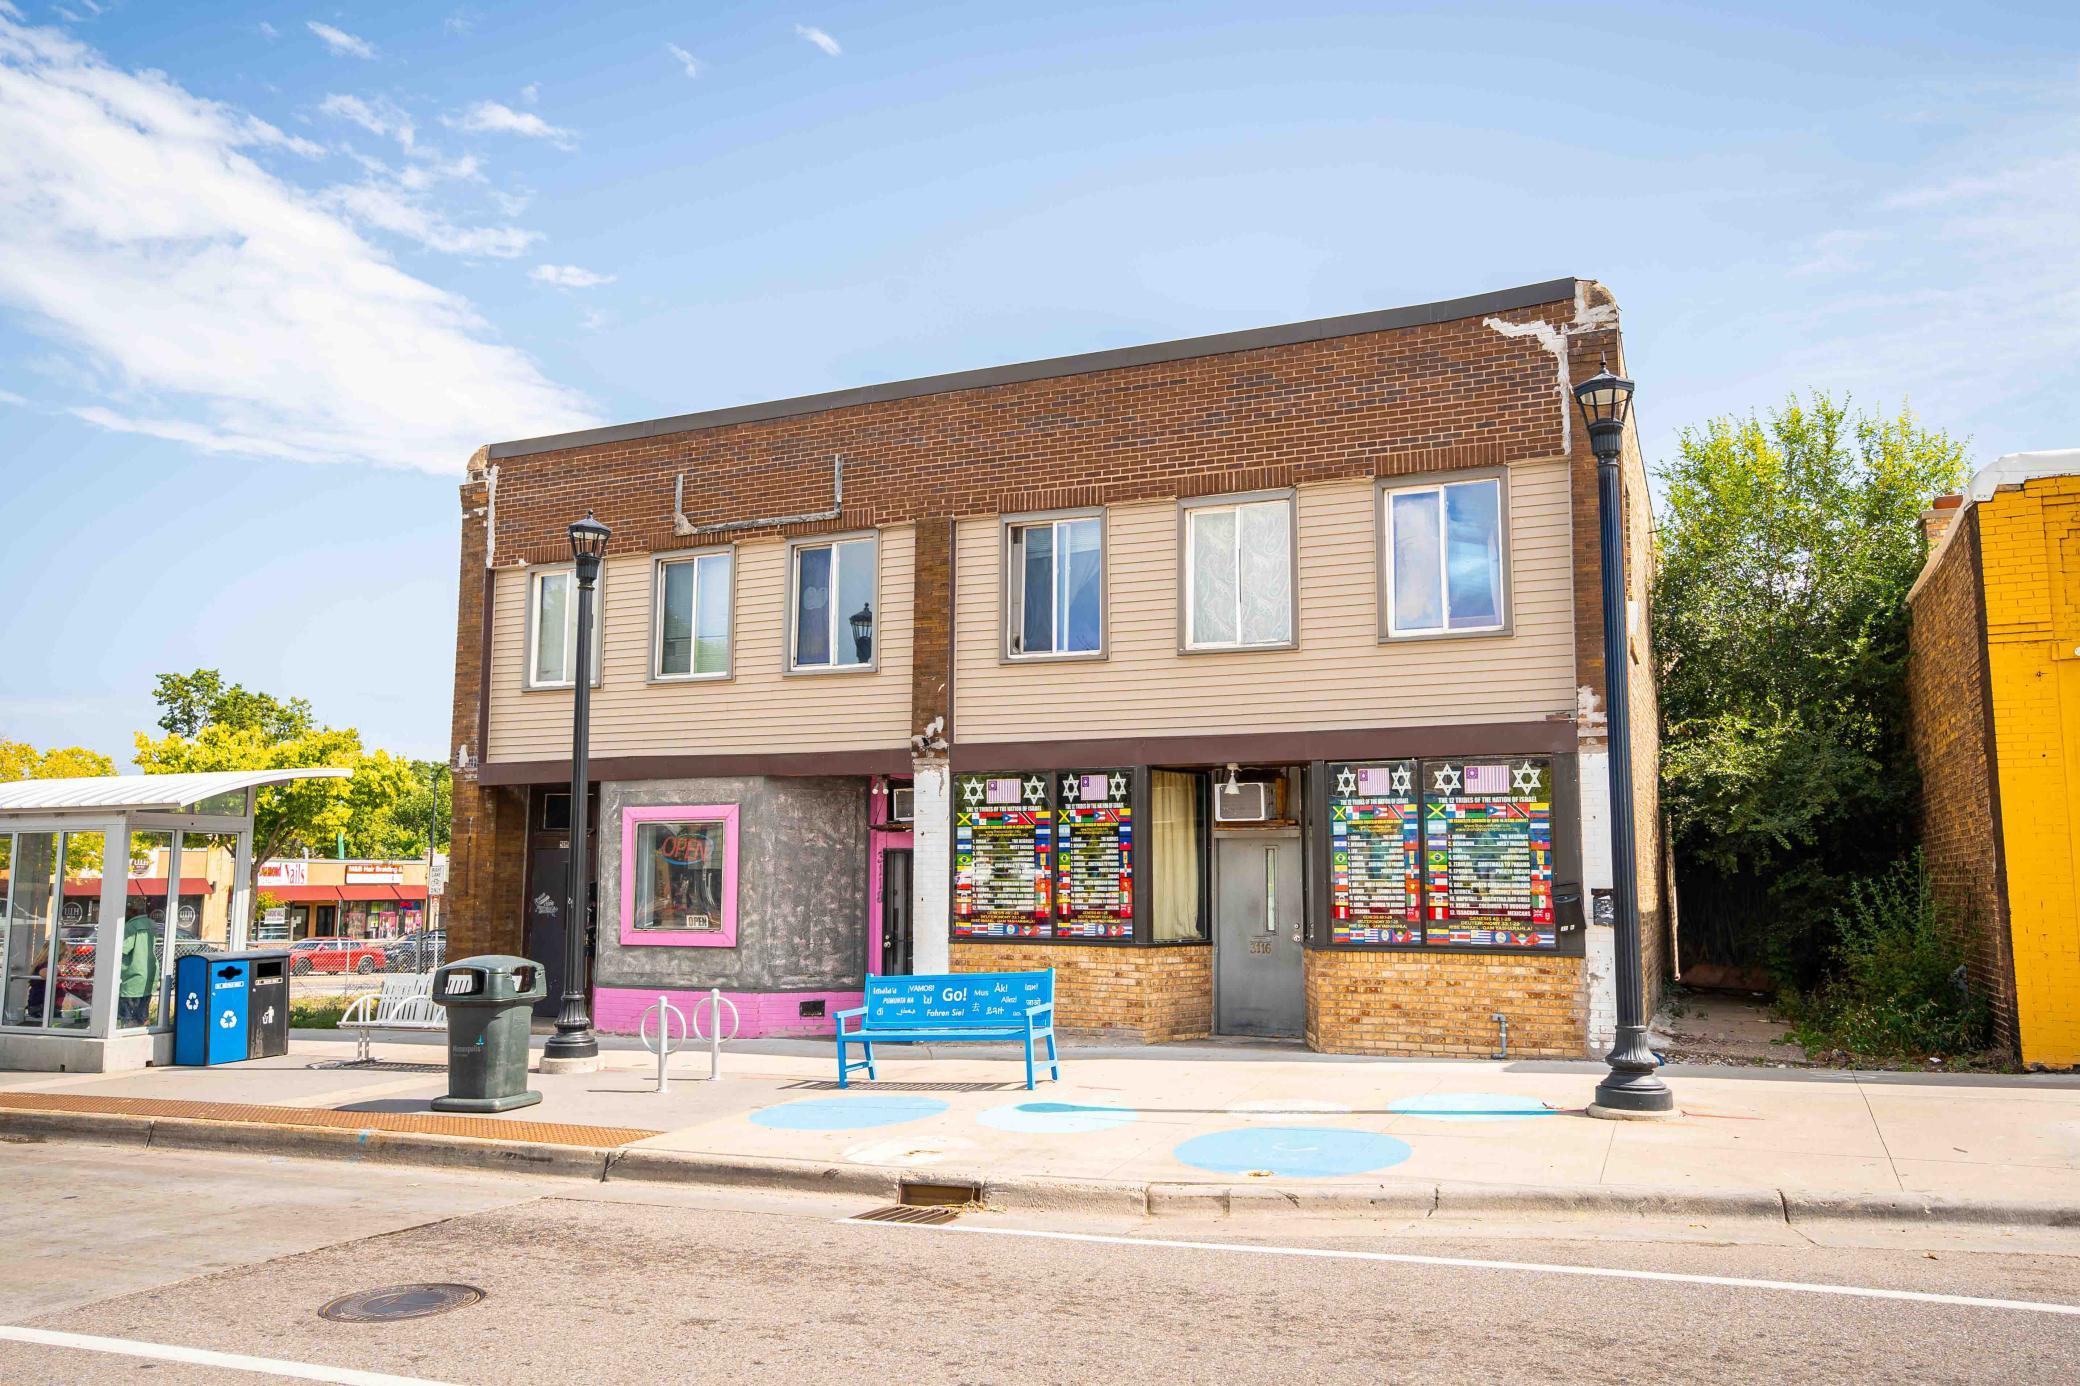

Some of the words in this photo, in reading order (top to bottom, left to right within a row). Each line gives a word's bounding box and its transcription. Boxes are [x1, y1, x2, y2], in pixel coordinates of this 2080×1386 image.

[661, 836, 706, 862] OPEN
[688, 916, 706, 926] OPEN
[908, 984, 934, 993] ¡VAMOS!
[942, 987, 967, 1002] Go!
[972, 1002, 980, 1012] 去
